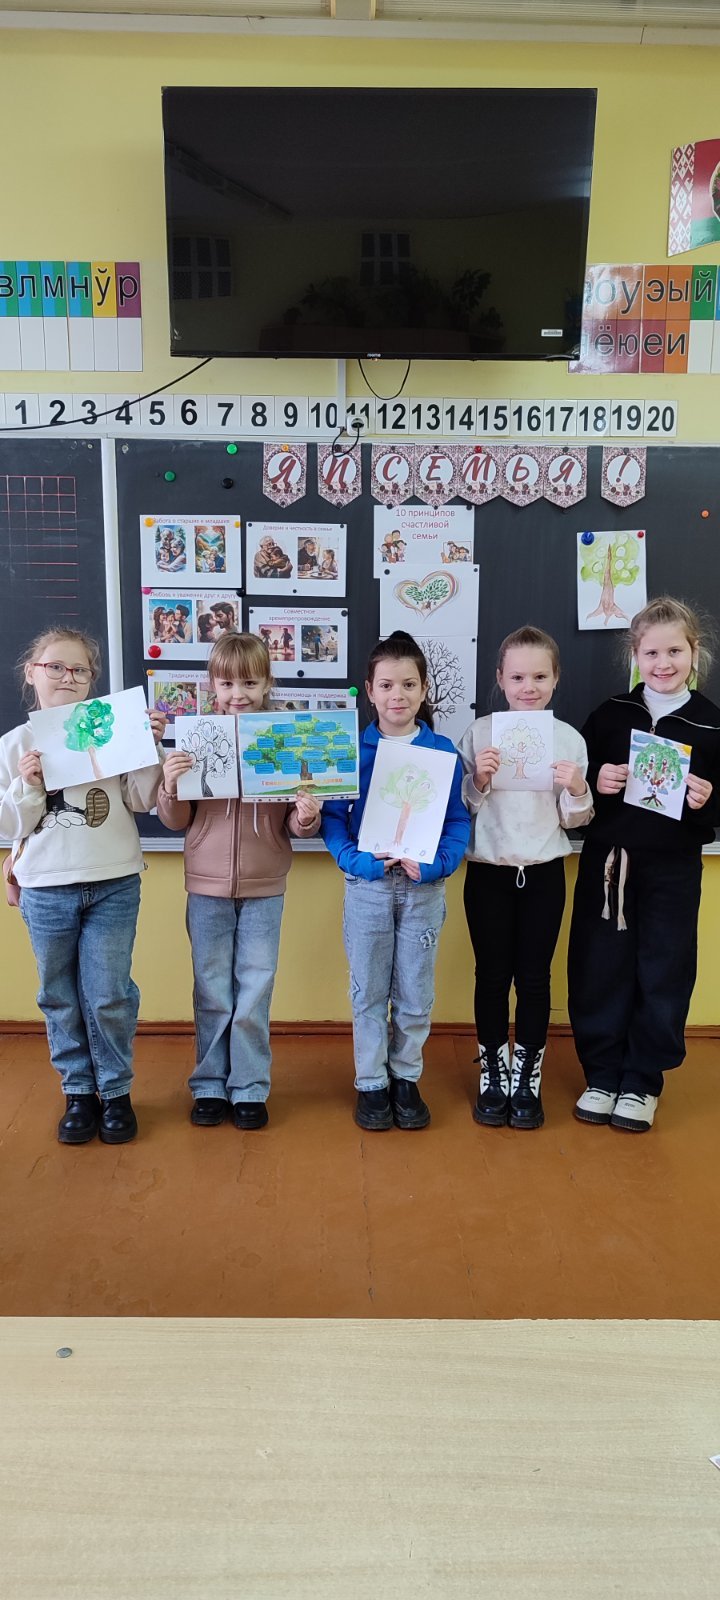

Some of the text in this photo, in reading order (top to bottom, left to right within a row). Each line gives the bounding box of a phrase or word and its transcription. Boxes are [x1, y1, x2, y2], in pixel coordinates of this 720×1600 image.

[15, 400, 27, 424] 1
[49, 400, 66, 425] 2
[81, 400, 98, 425] 3
[115, 400, 133, 425] 4
[149, 401, 166, 425] 5
[180, 399, 198, 425] 6
[217, 402, 234, 426] 7
[251, 402, 268, 427] 8
[283, 402, 298, 427] 9
[310, 402, 338, 428] 10
[377, 403, 406, 429] 12
[411, 403, 441, 430] 13
[445, 404, 474, 431] 14
[478, 405, 508, 431] 15
[512, 405, 541, 432] 16
[545, 406, 574, 432] 17
[579, 406, 607, 432] 18
[612, 405, 642, 431] 19
[646, 406, 675, 432] 20
[271, 455, 297, 489] Я
[396, 509, 455, 518] 10 принципов
[401, 520, 449, 528] счастливой
